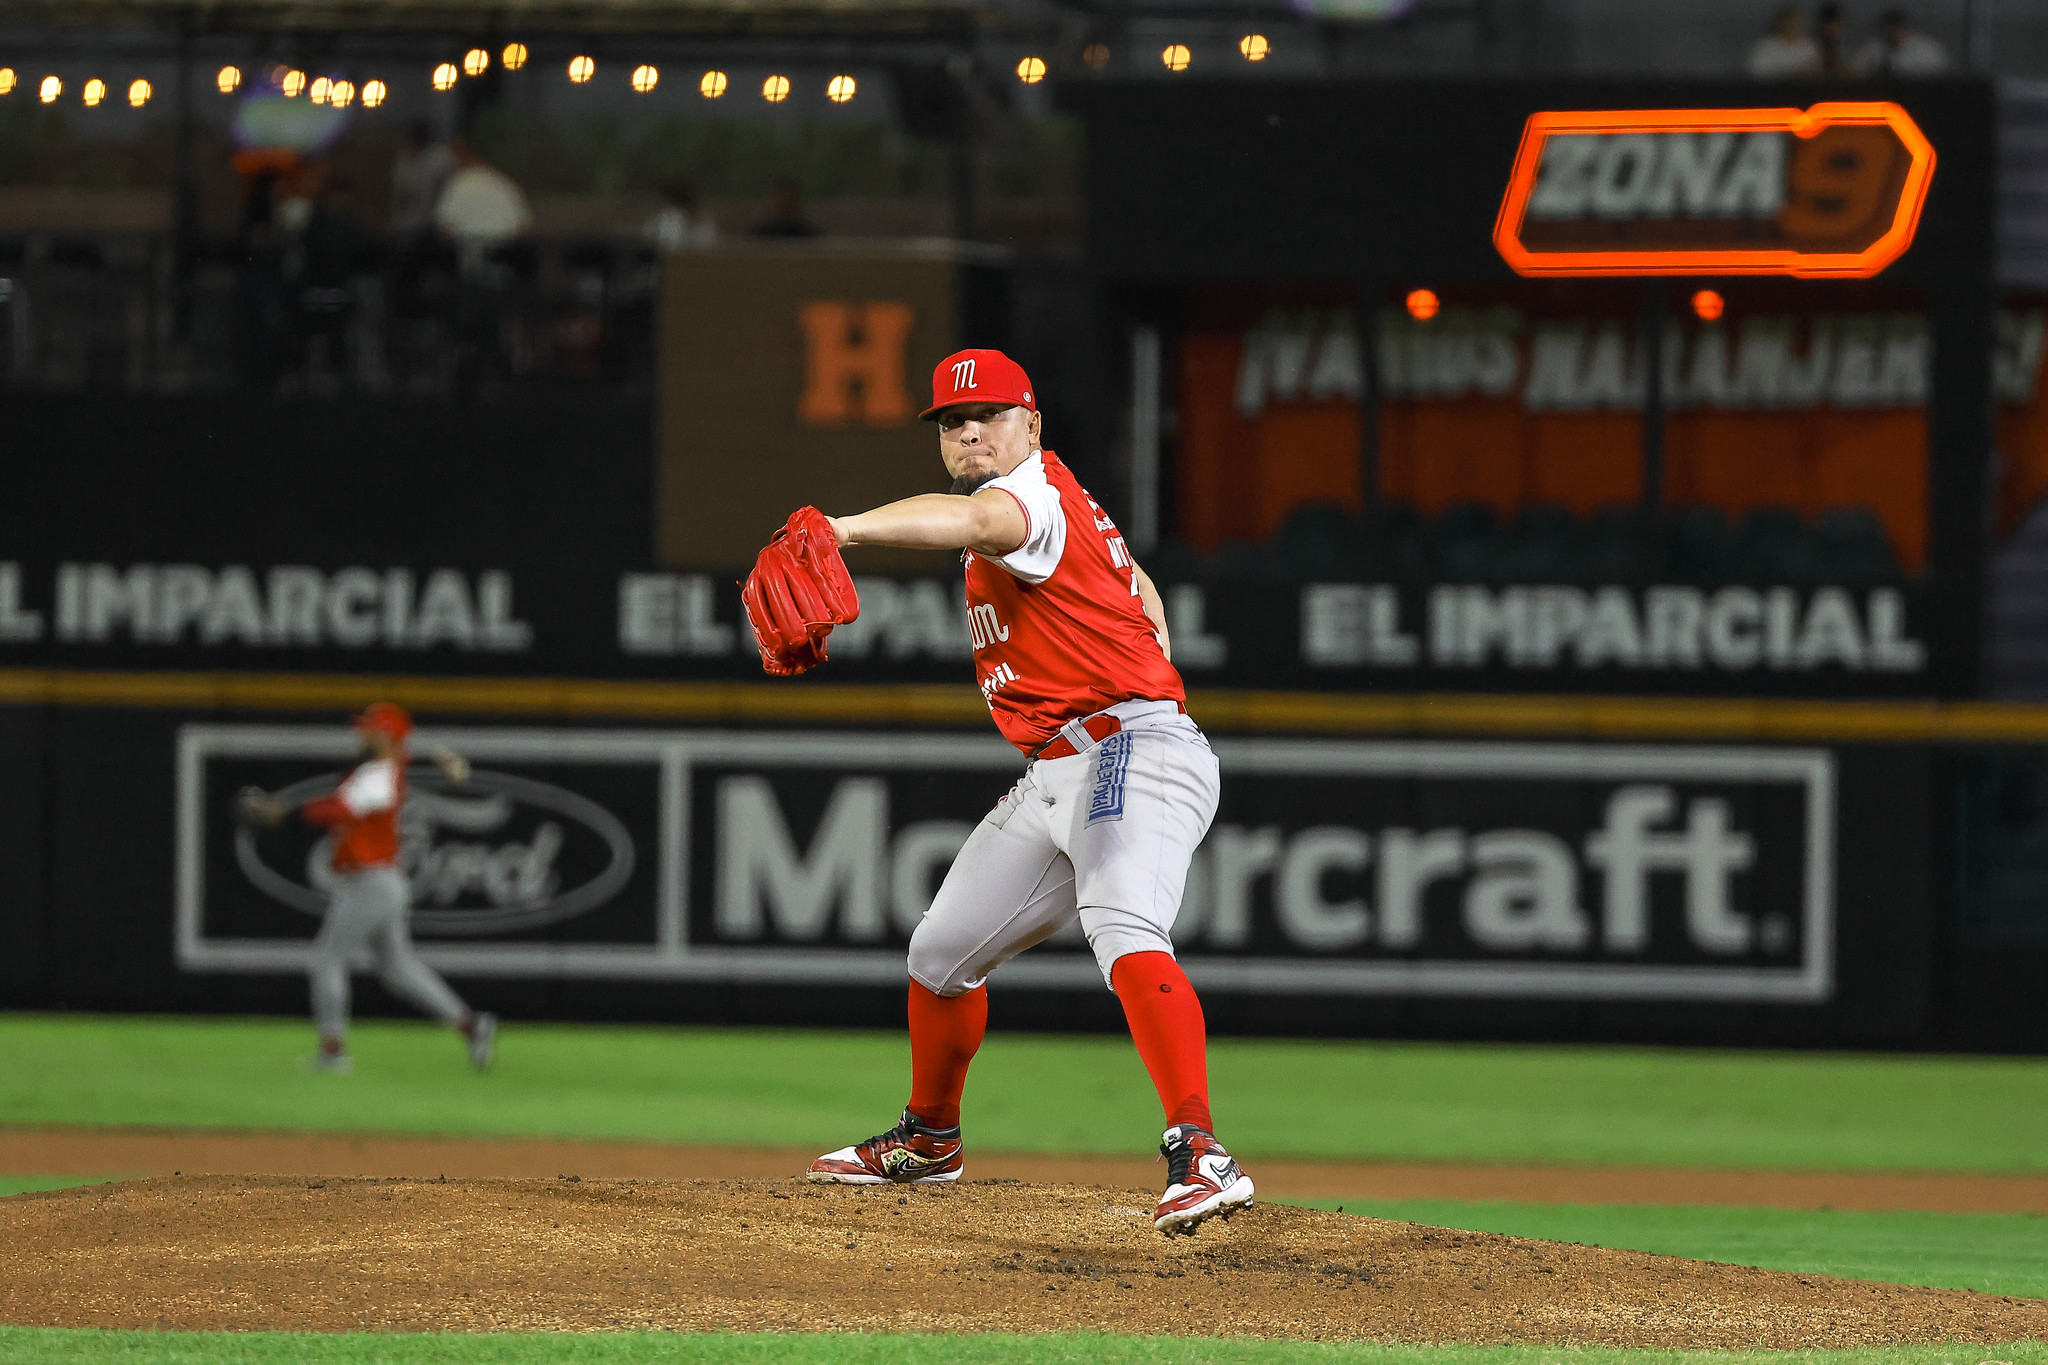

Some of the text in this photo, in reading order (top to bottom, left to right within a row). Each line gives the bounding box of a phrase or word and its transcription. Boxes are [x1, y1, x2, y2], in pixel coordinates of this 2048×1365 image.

[1527, 123, 1895, 238] ZONA 9
[799, 302, 913, 426] H
[55, 562, 533, 651] IMPARCIAL
[617, 573, 736, 656] EL
[1304, 583, 1420, 668] EL
[1426, 584, 1927, 672] IMPARCIAL
[714, 773, 1753, 952] Morcraft
